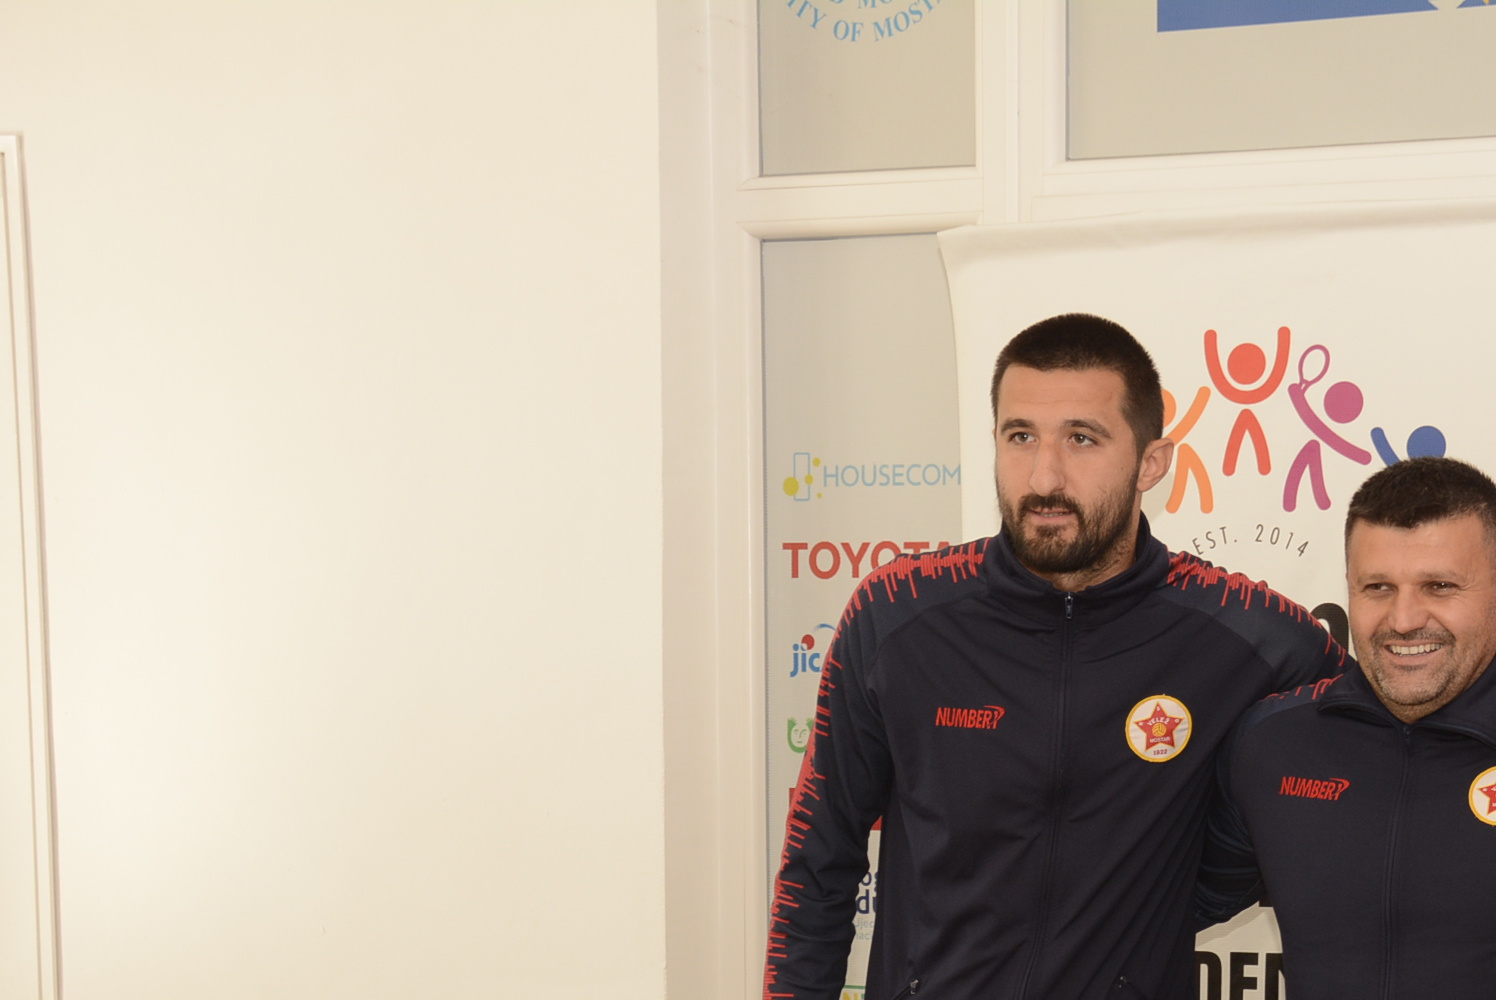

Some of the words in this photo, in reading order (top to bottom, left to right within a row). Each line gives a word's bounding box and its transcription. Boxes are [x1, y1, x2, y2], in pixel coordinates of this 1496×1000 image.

[833, 19, 864, 42] OF
[871, 0, 942, 42] MOST
[823, 464, 961, 487] HOUSECOM
[1192, 525, 1239, 556] EST.
[1254, 524, 1310, 557] 2014
[782, 541, 951, 580] TOYO
